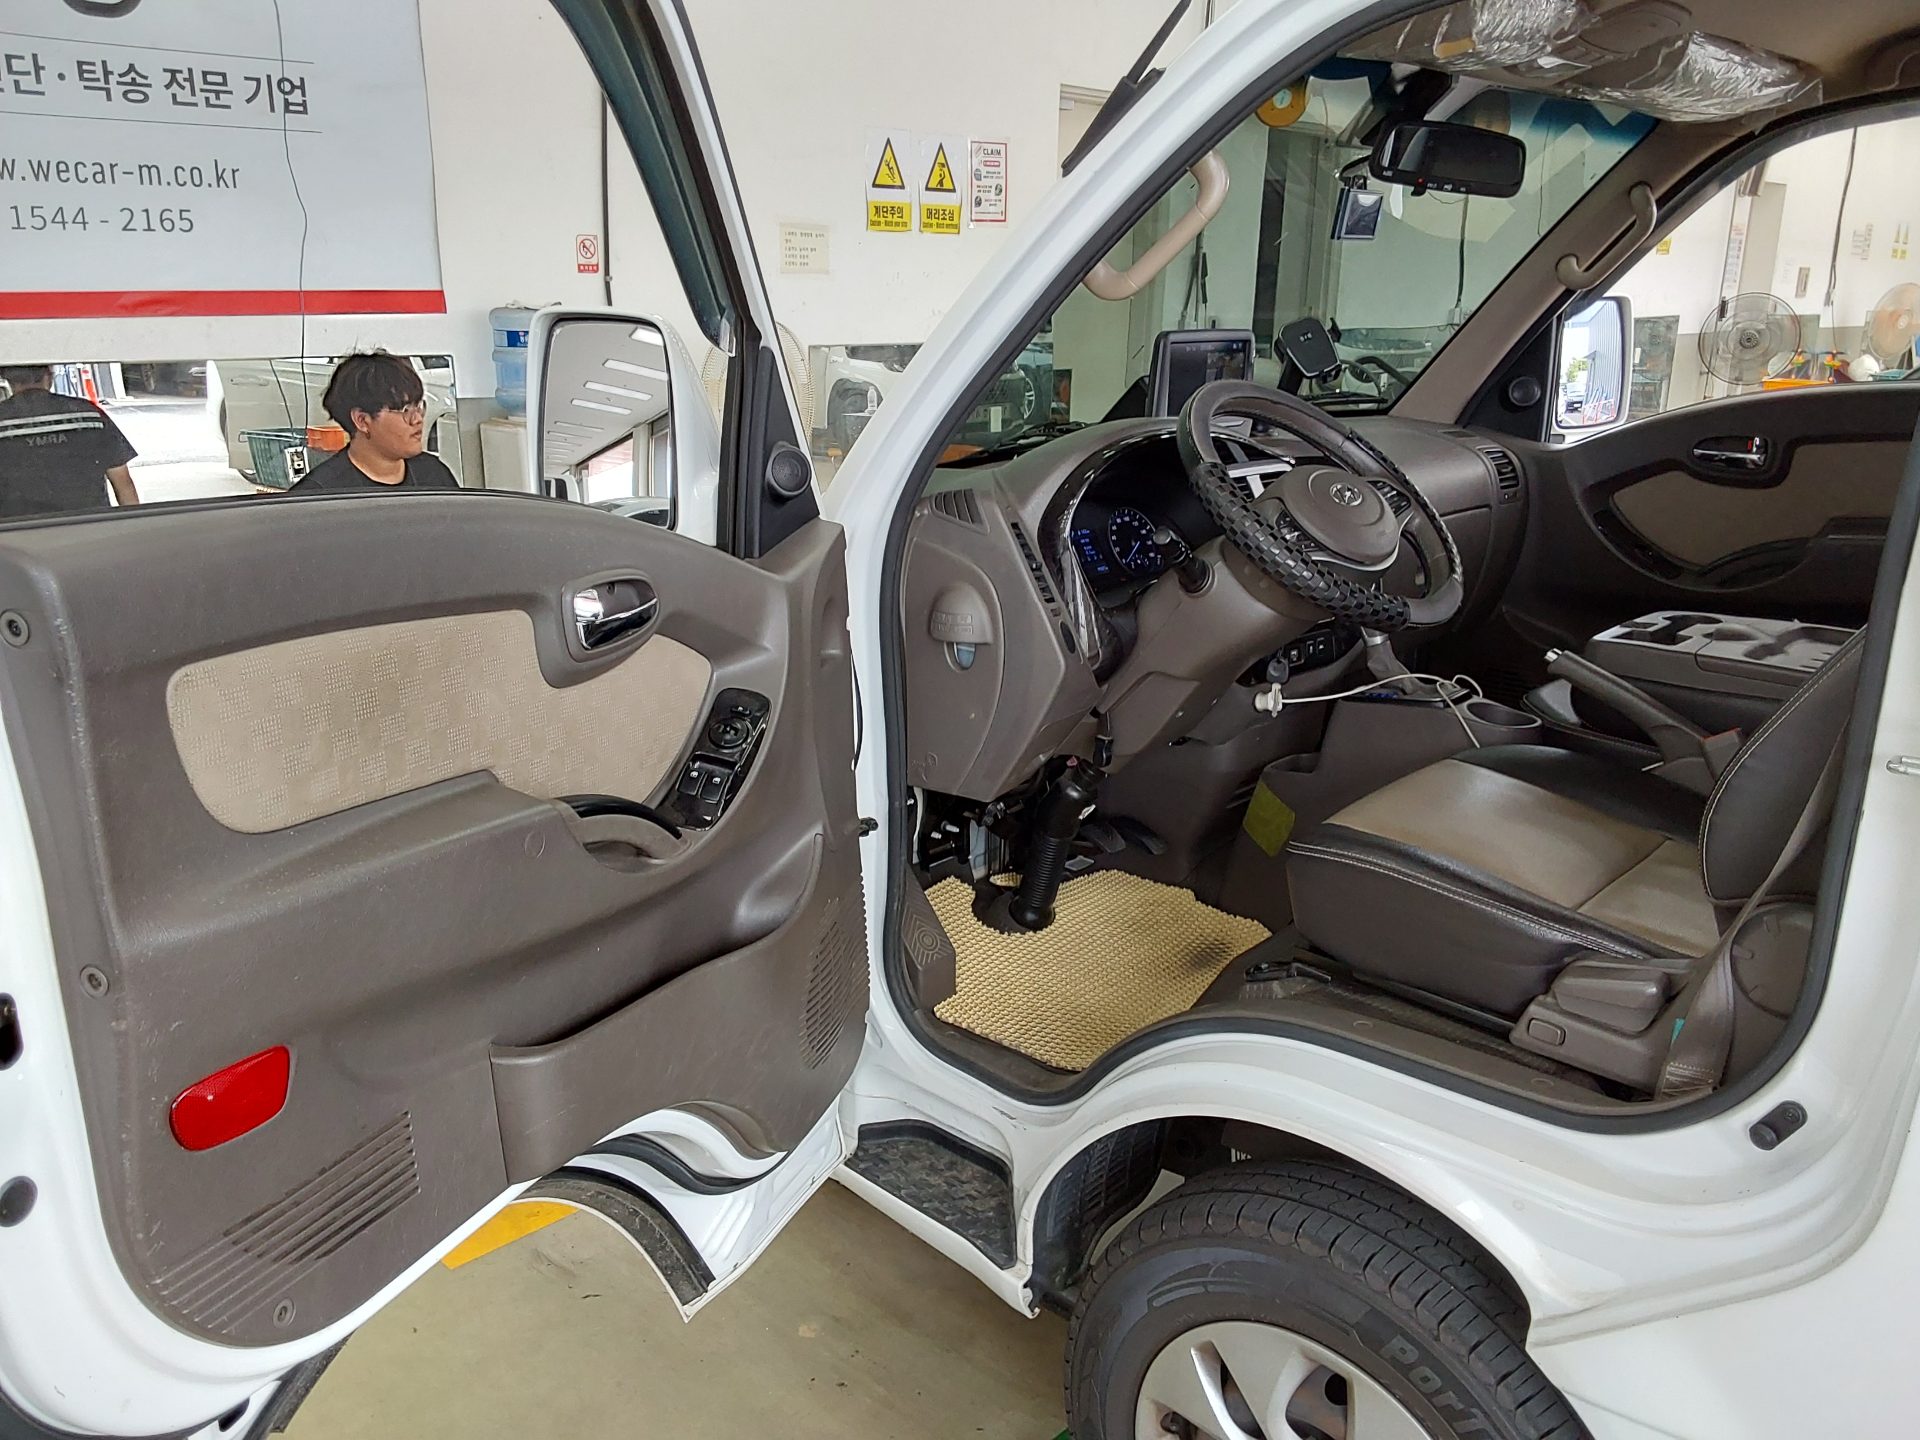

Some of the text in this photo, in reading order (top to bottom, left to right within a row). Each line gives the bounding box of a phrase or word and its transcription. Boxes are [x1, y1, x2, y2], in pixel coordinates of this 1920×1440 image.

[162, 67, 234, 109] 전문
[243, 74, 309, 115] 기업
[873, 205, 904, 219] 계단주의
[926, 208, 955, 222] 머리조심
